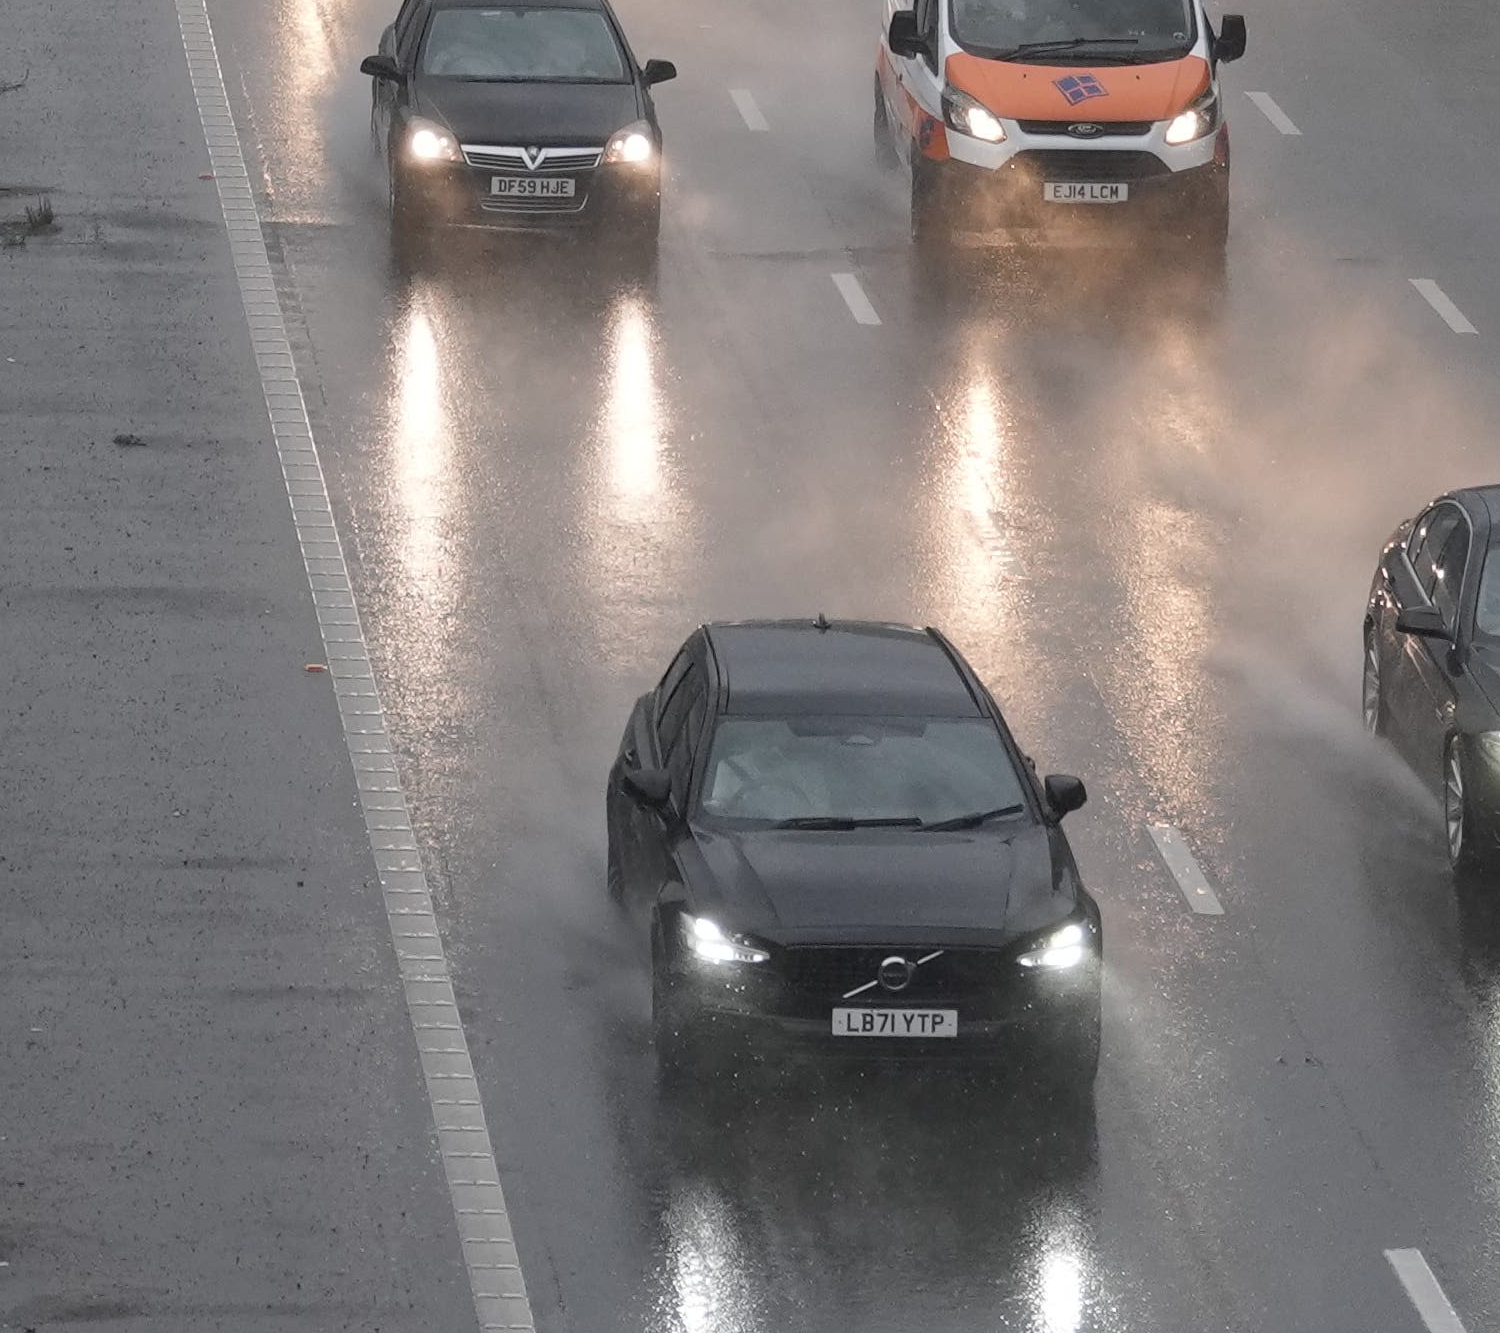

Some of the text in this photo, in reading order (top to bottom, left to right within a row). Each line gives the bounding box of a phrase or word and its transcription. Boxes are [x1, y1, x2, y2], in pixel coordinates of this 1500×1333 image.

[498, 179, 569, 194] DF59 HJE
[1053, 184, 1119, 200] EJ14 LCM
[846, 1012, 944, 1033] LB71 YTP
